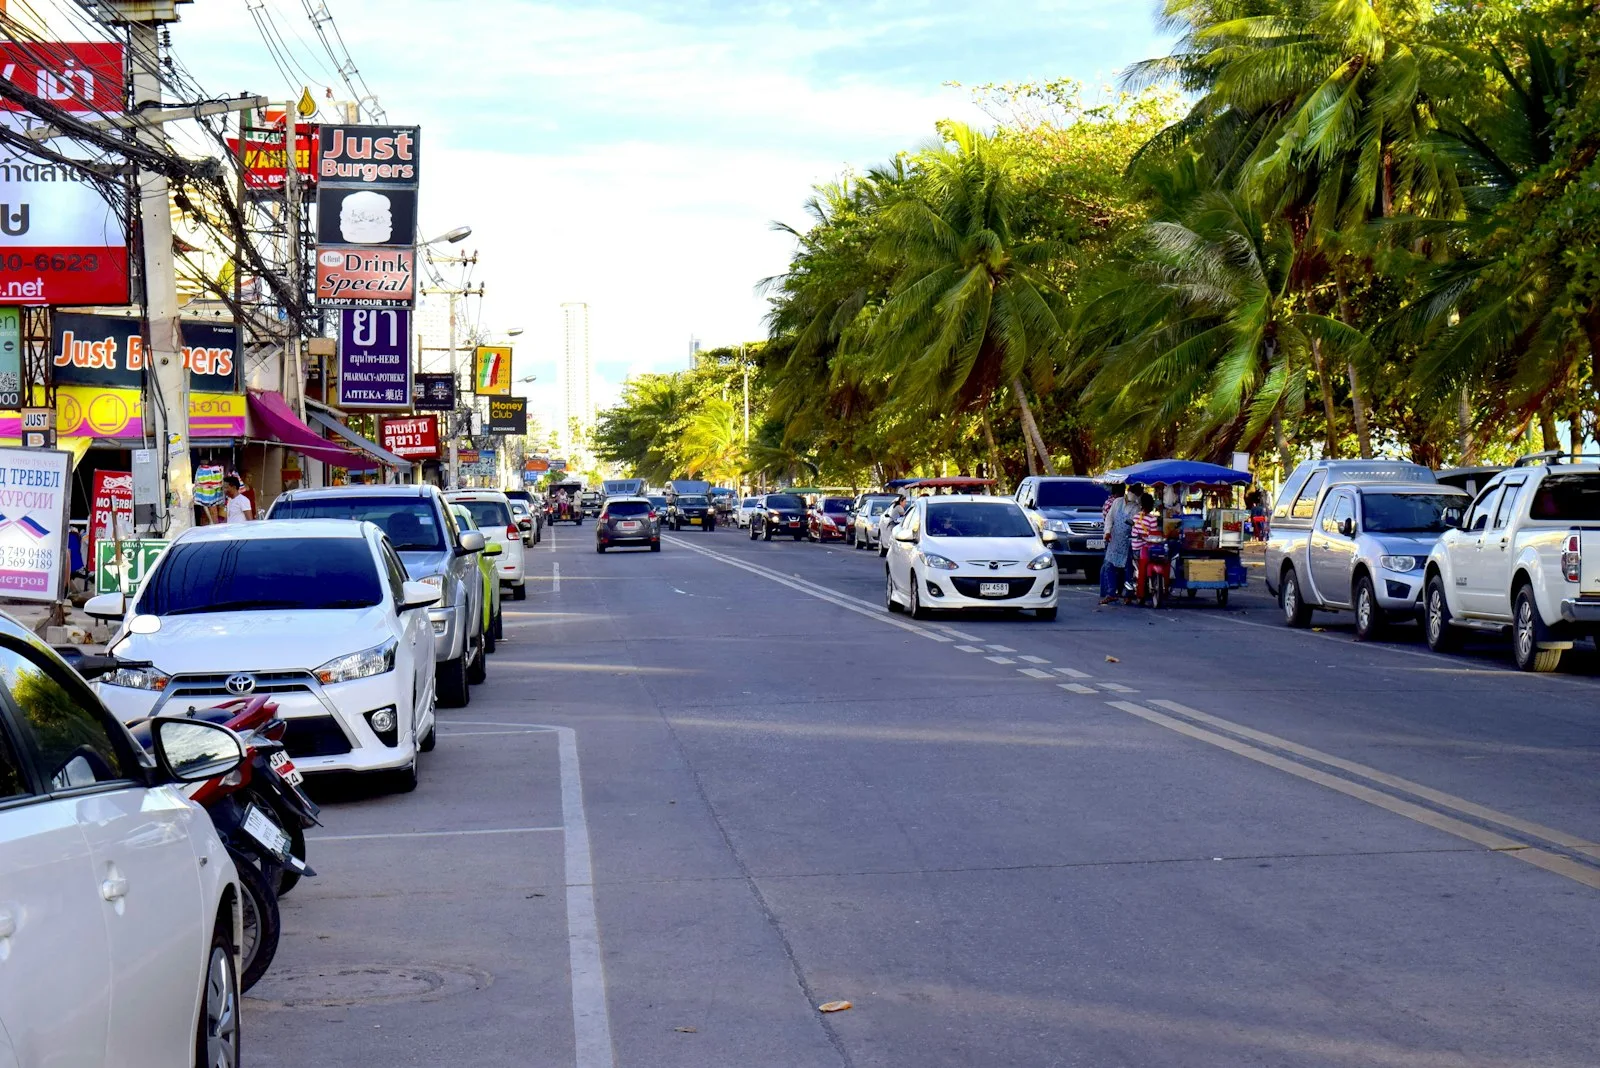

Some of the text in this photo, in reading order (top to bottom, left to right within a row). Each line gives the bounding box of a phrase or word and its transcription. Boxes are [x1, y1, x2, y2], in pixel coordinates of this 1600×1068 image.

[323, 129, 413, 160] Just
[321, 158, 414, 182] Burgers
[345, 253, 410, 273] Drink
[0, 277, 44, 297] .net
[320, 273, 410, 297] Special
[320, 298, 352, 306] HAPPY
[353, 309, 397, 347] ยา
[54, 330, 233, 375] Just Bers
[491, 401, 523, 411] Money
[492, 410, 513, 419] Club
[25, 414, 47, 426] JUST
[418, 421, 428, 433] 10
[414, 434, 422, 446] 3
[11, 468, 60, 488] ТРЕВЕЛ
